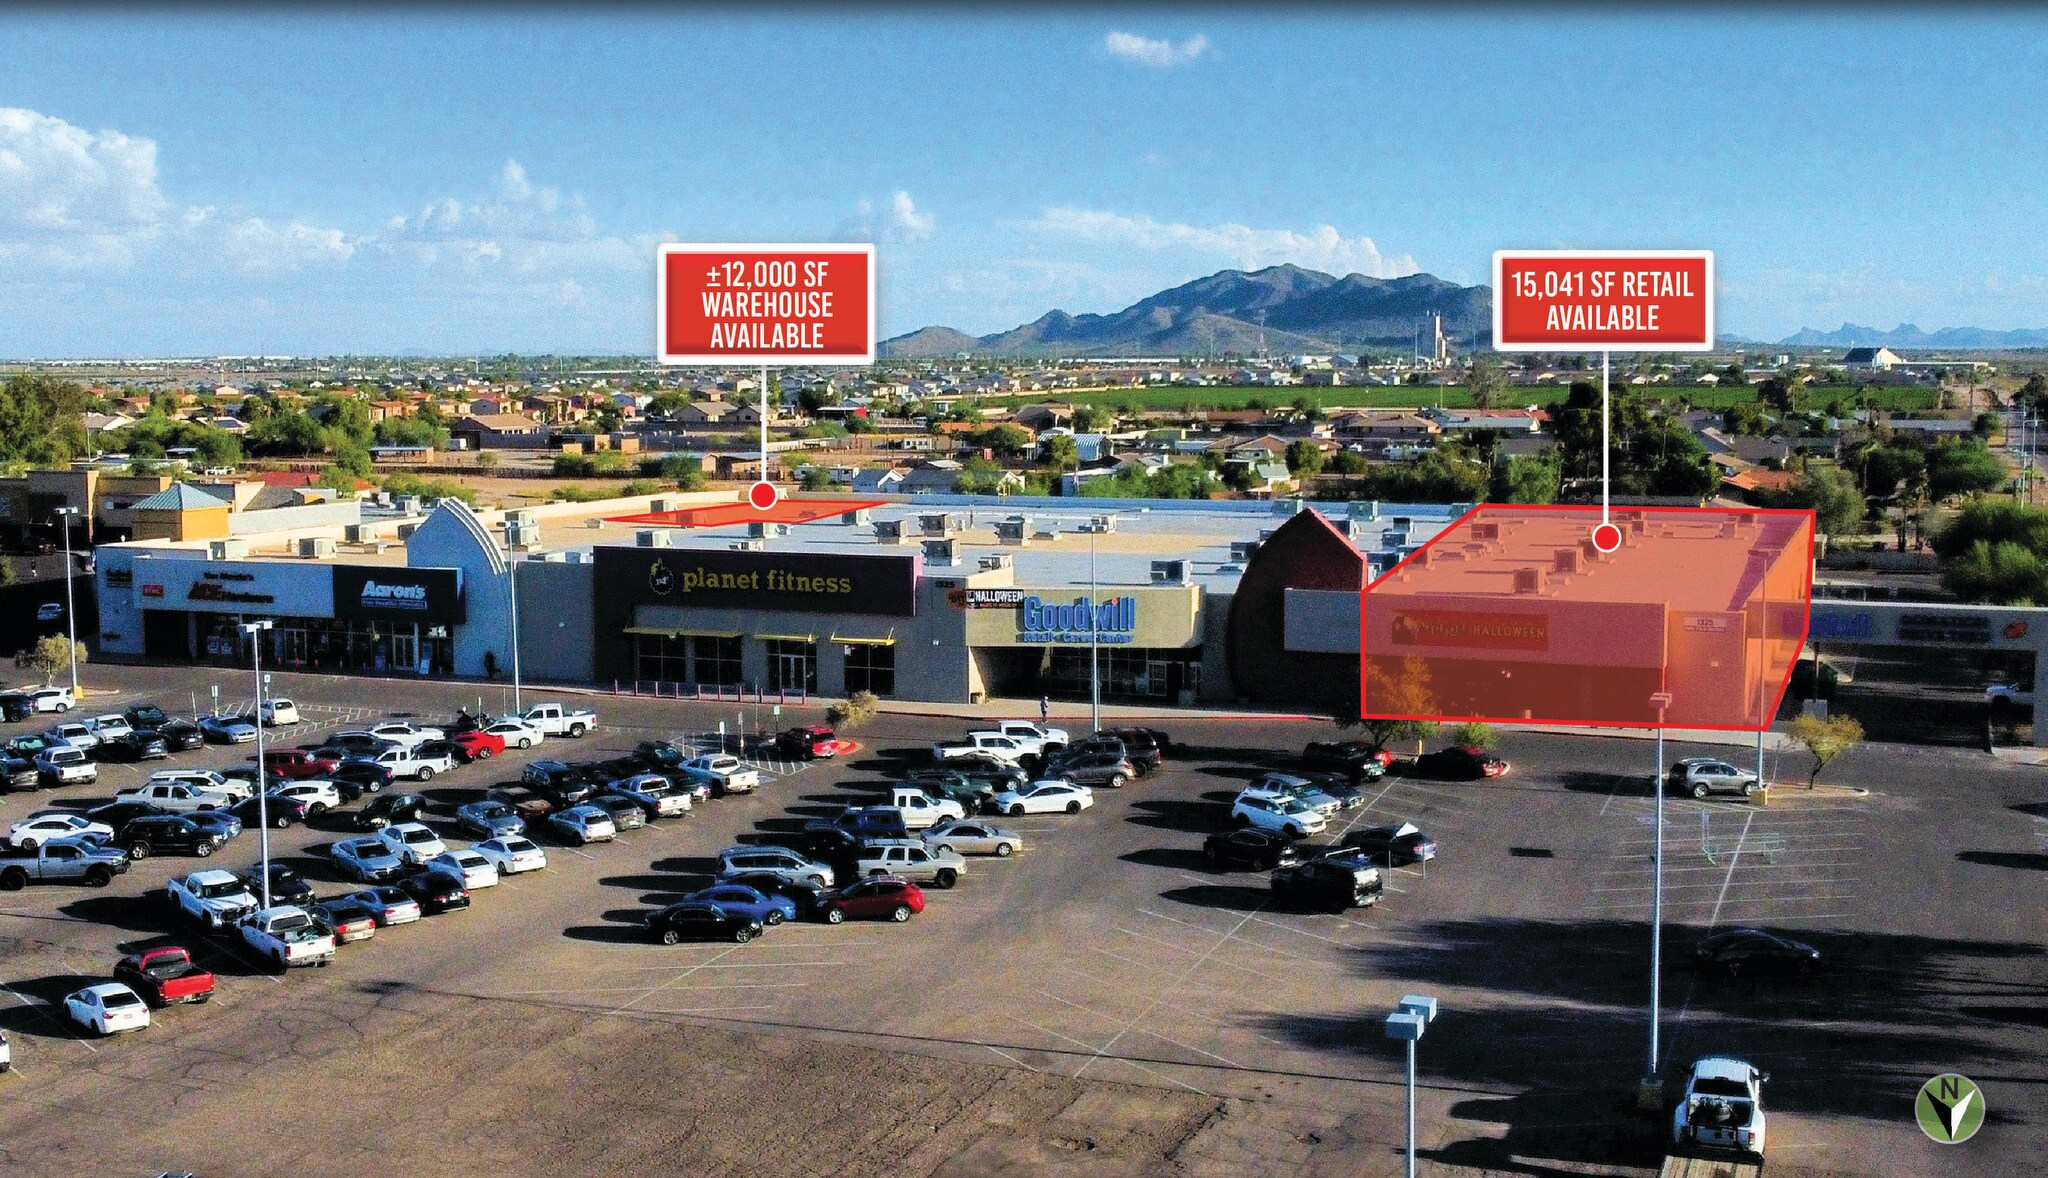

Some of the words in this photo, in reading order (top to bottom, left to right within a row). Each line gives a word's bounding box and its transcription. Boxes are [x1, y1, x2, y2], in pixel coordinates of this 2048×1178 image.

[682, 567, 759, 592] planet
[767, 570, 851, 593] fitness
[361, 581, 426, 599] Aaron's
[975, 590, 1023, 602] HALLOWEEN
[1024, 596, 1135, 631] Goodwill
[1473, 625, 1545, 639] HALLOWEEN
